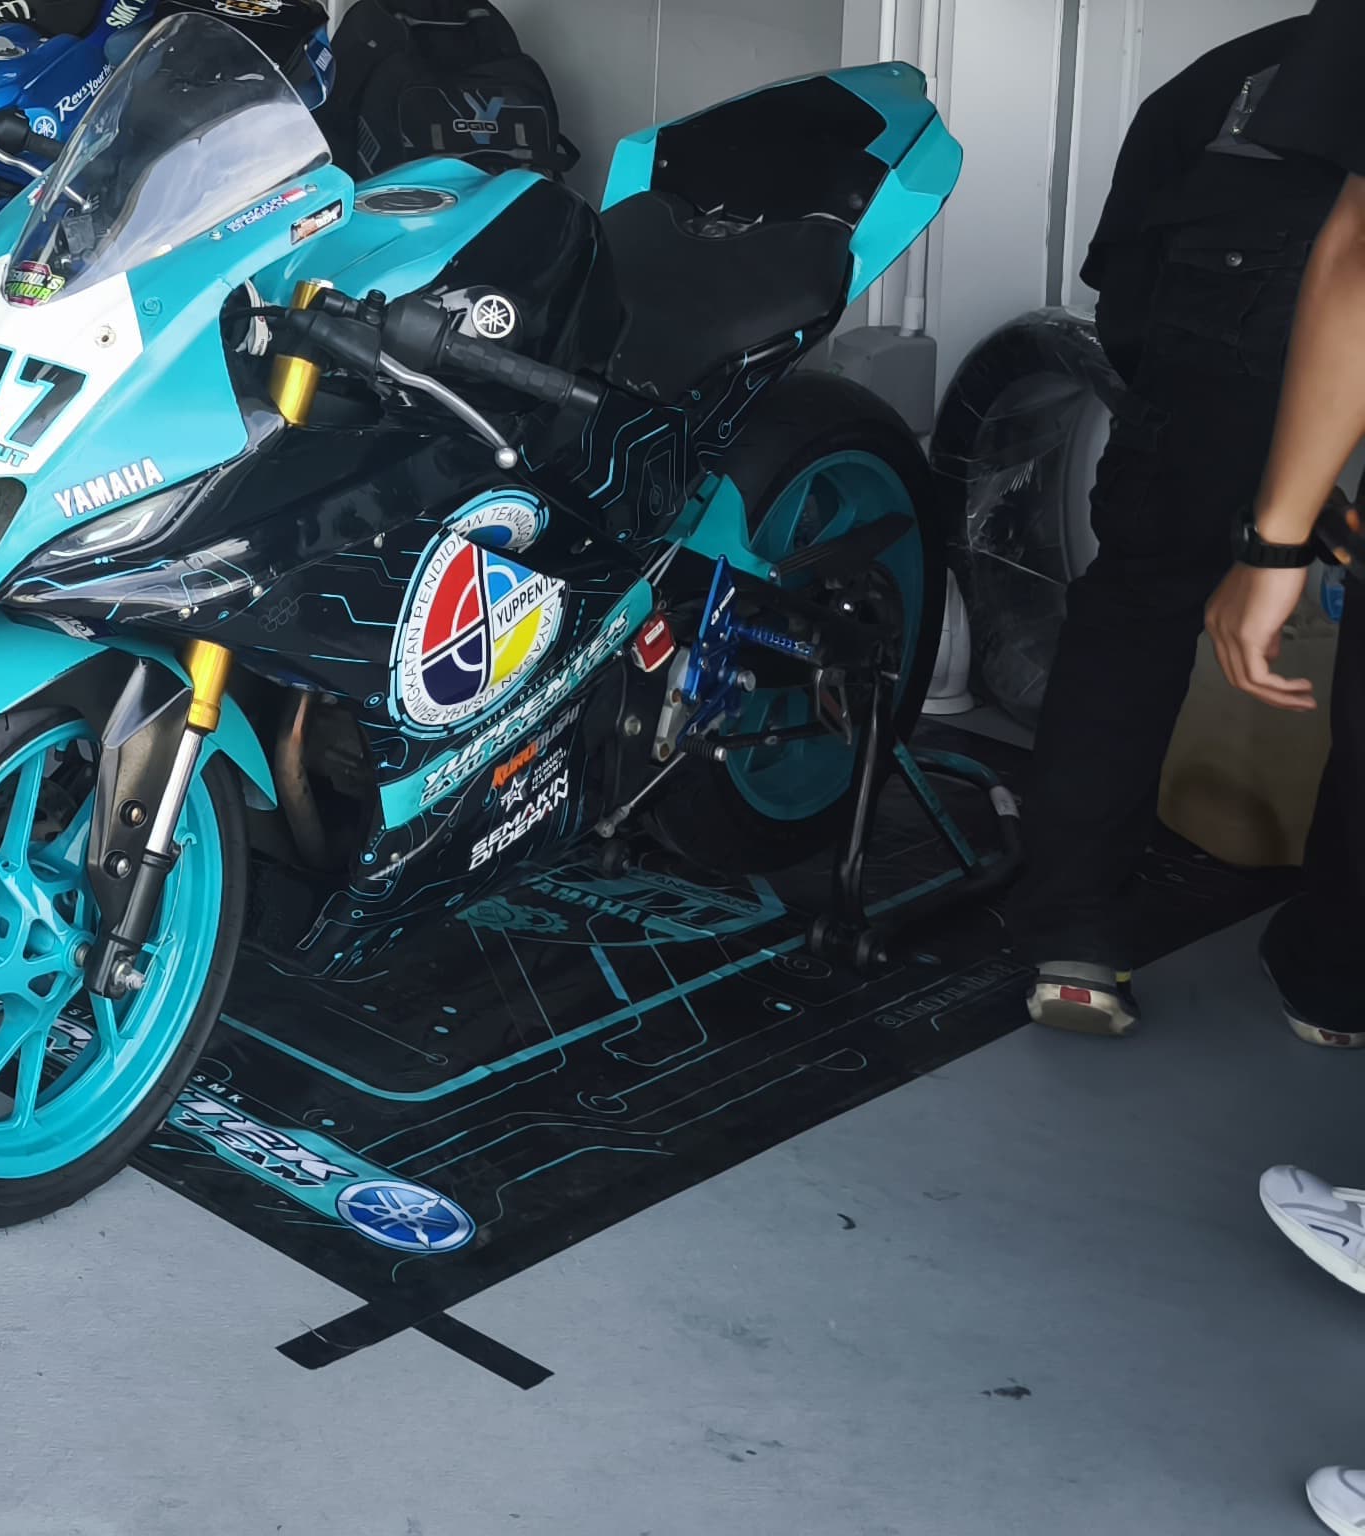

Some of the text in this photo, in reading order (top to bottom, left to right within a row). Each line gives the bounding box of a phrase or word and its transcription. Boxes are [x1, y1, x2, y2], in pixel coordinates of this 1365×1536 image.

[456, 121, 496, 133] OGIO
[53, 456, 167, 519] YAMAHA
[469, 792, 569, 871] DI DEPAN
[470, 768, 569, 857] SEMAKIN
[193, 1072, 244, 1104] SMK
